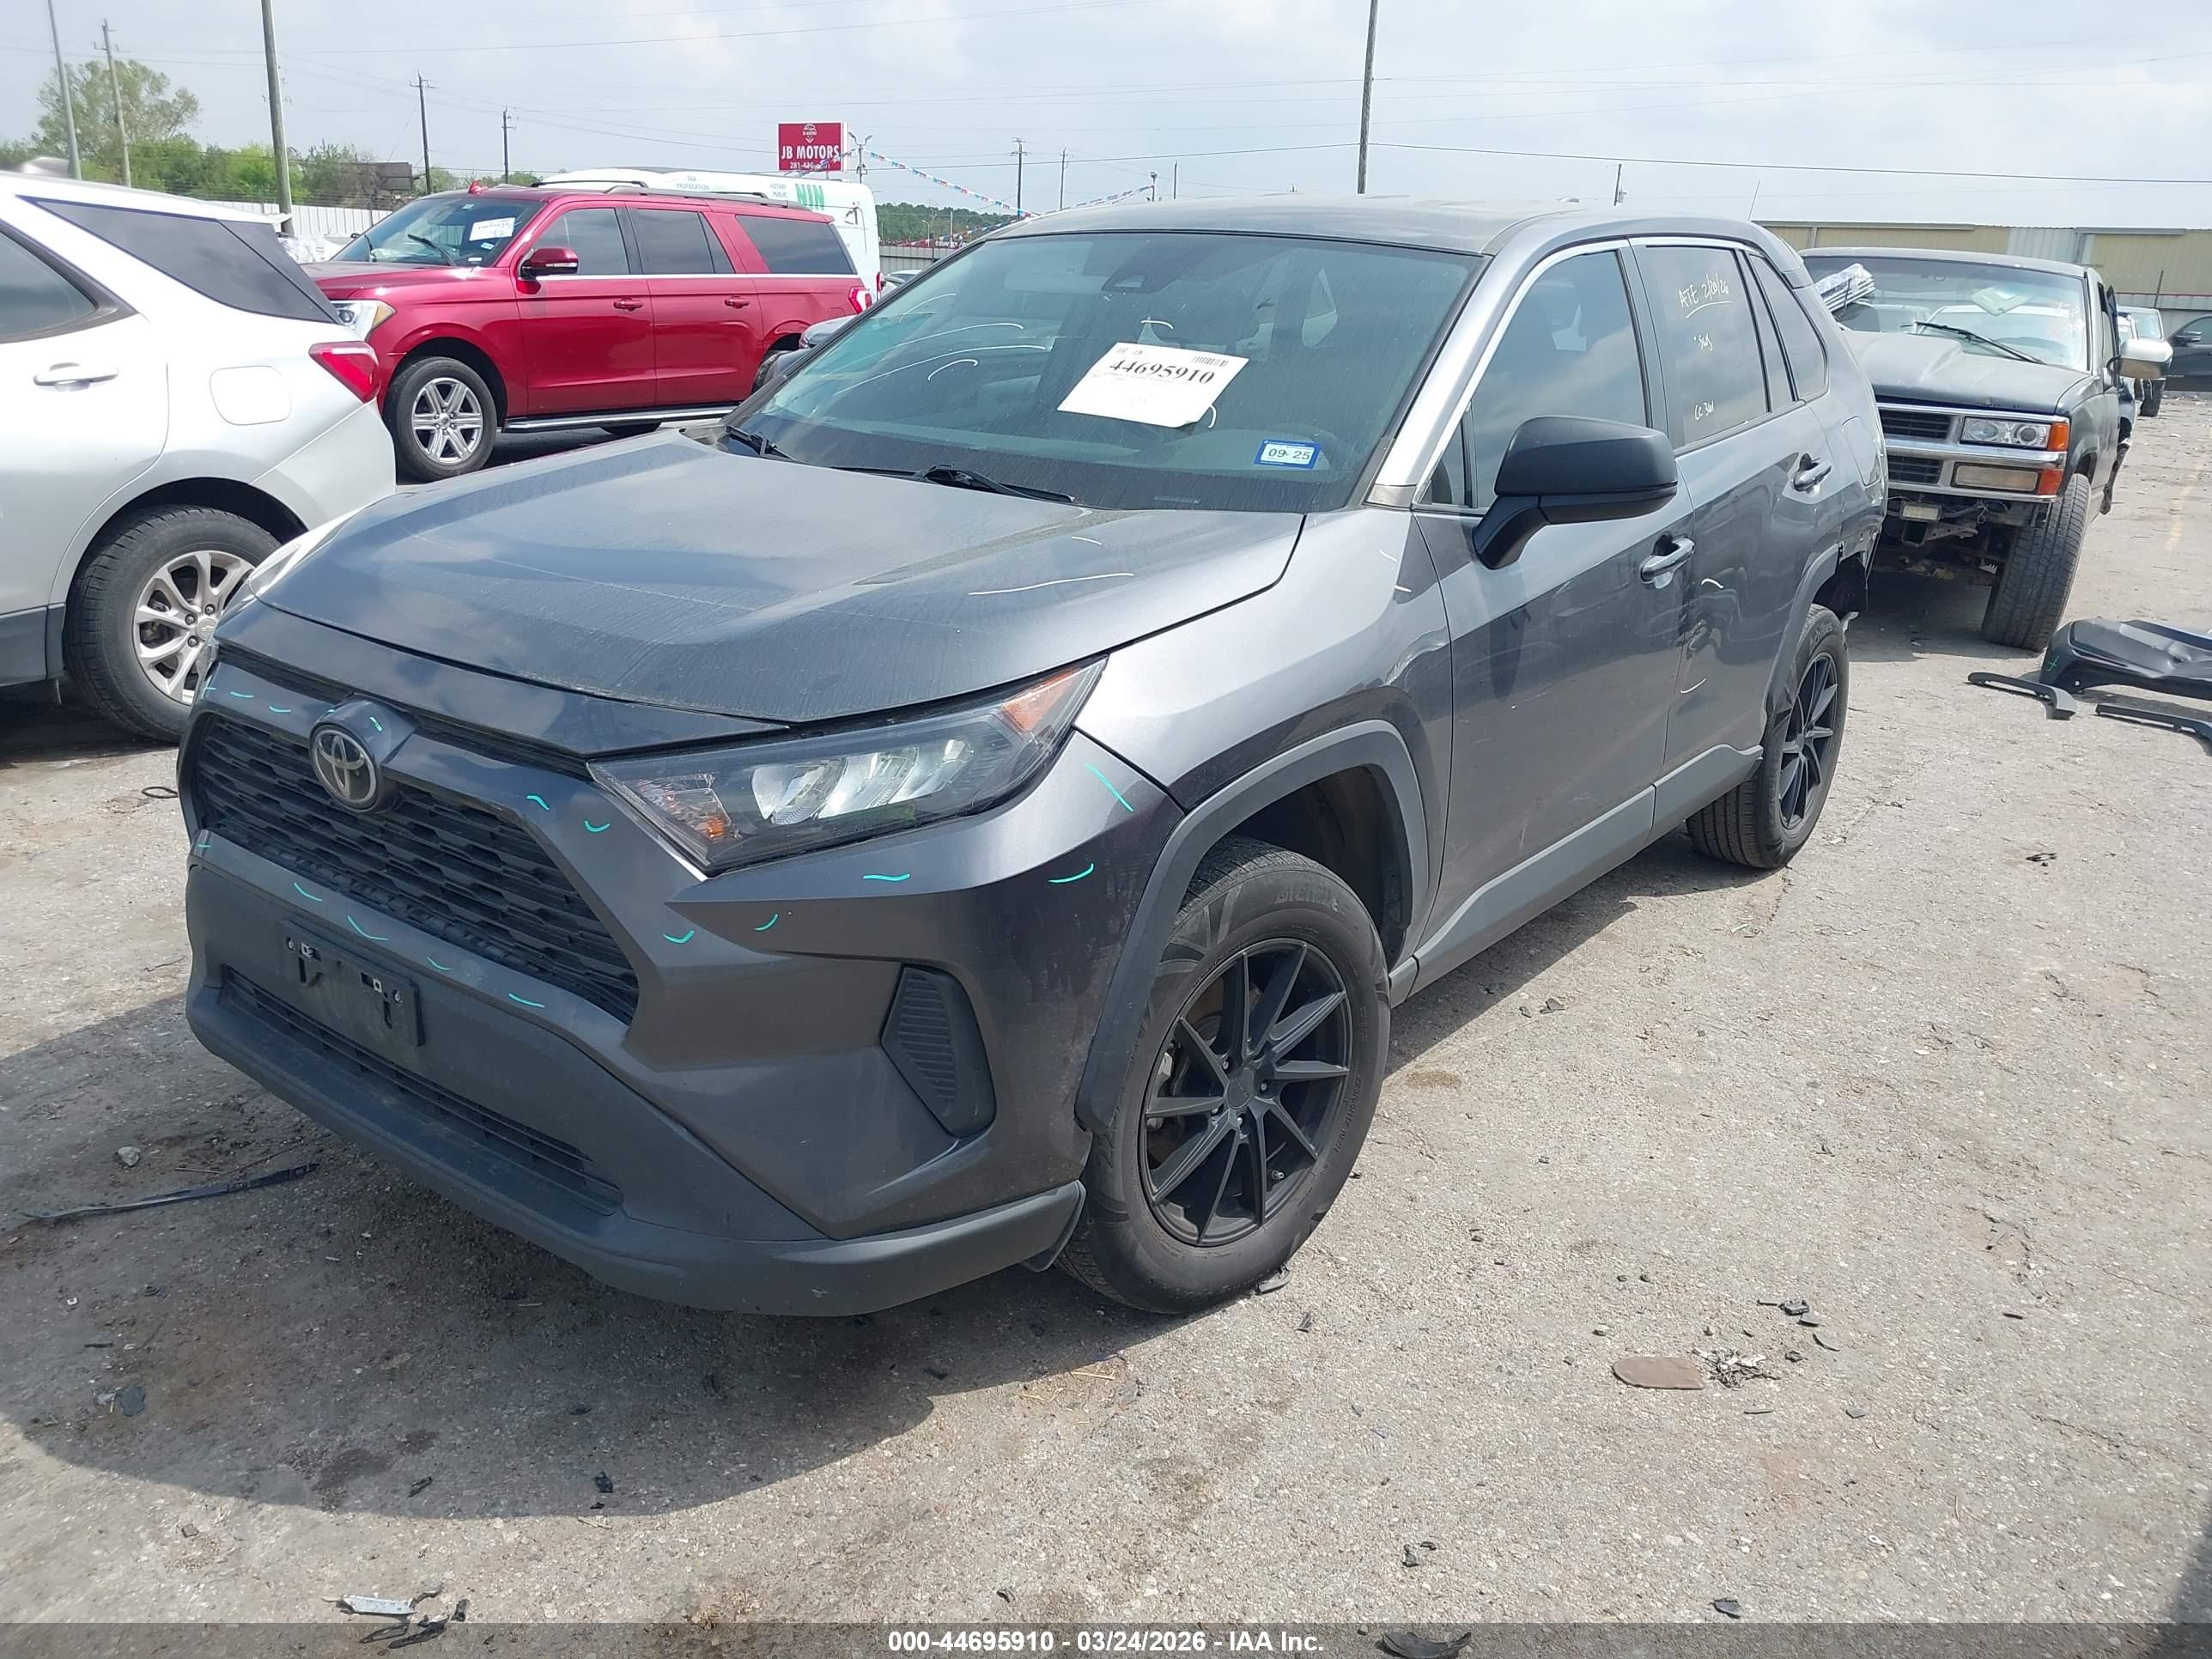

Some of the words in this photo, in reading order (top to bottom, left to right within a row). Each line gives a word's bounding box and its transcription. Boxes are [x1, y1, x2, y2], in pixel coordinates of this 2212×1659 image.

[781, 145, 793, 160] JB
[796, 144, 840, 160] MOTORS
[1109, 359, 1216, 384] 44695910
